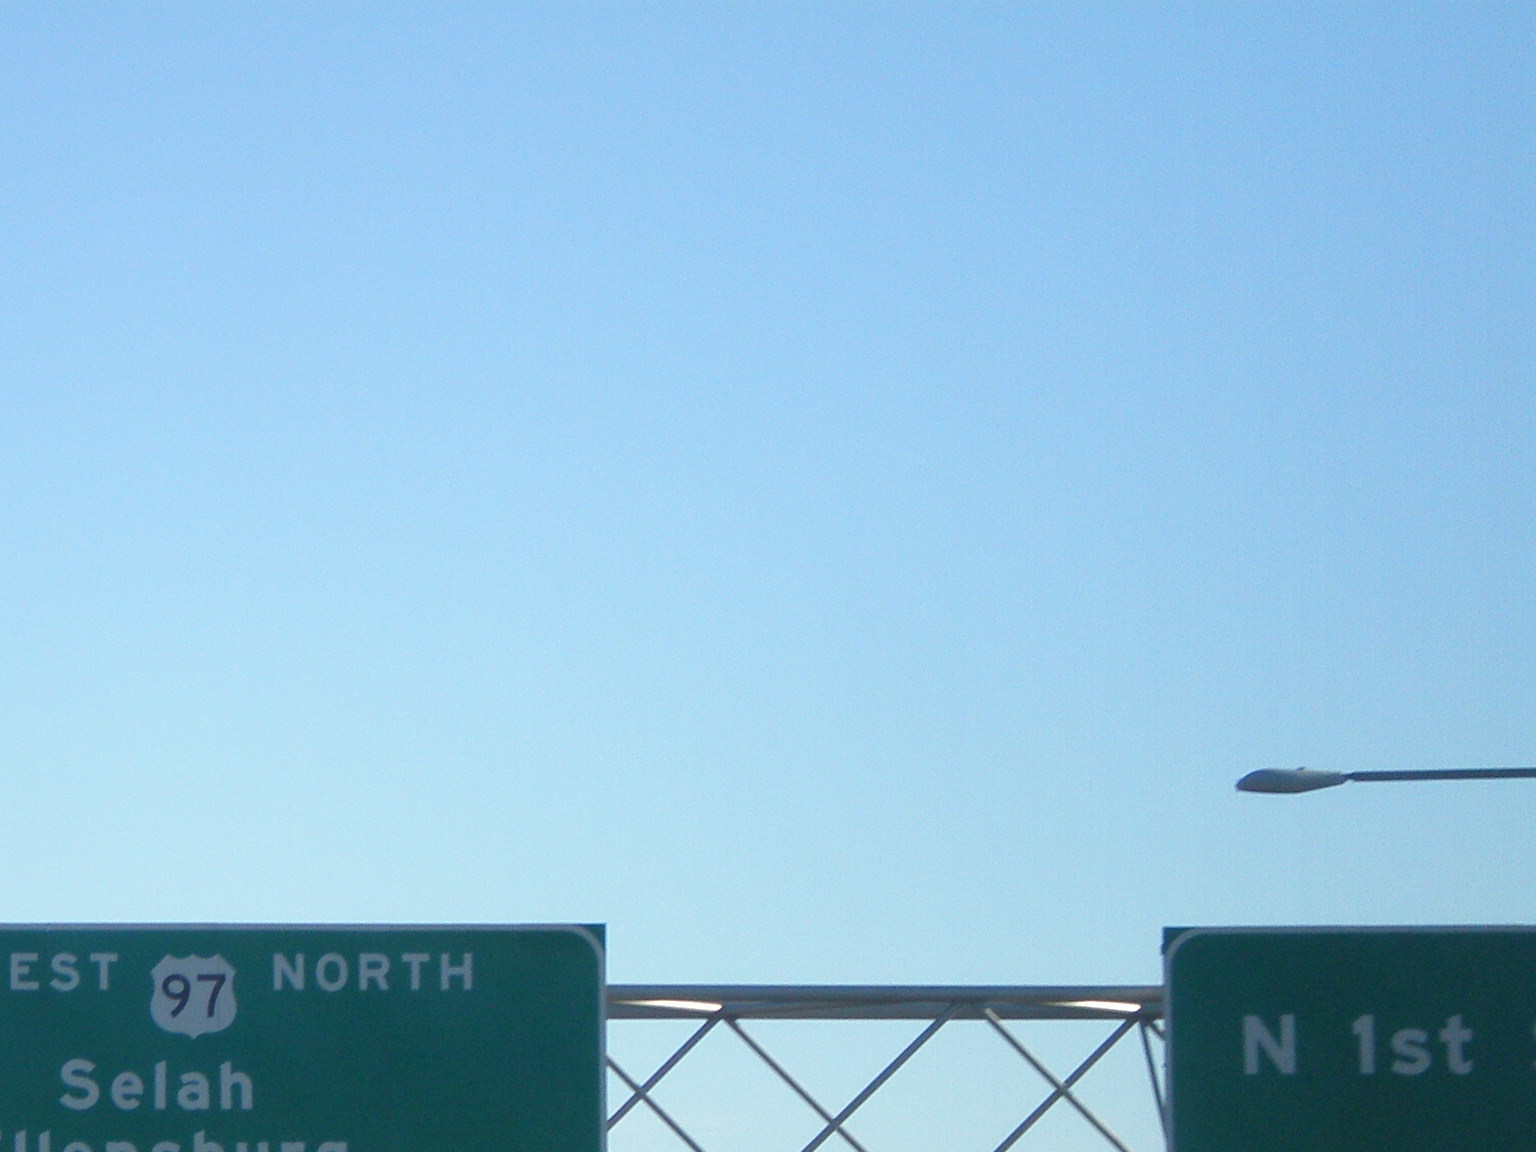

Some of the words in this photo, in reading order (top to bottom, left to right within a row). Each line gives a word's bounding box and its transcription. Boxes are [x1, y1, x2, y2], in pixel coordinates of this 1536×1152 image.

[161, 973, 227, 1019] 97
[273, 953, 474, 991] NORTH
[1241, 1013, 1296, 1075] N
[1352, 1012, 1474, 1075] 1st
[59, 1058, 254, 1110] Selah
